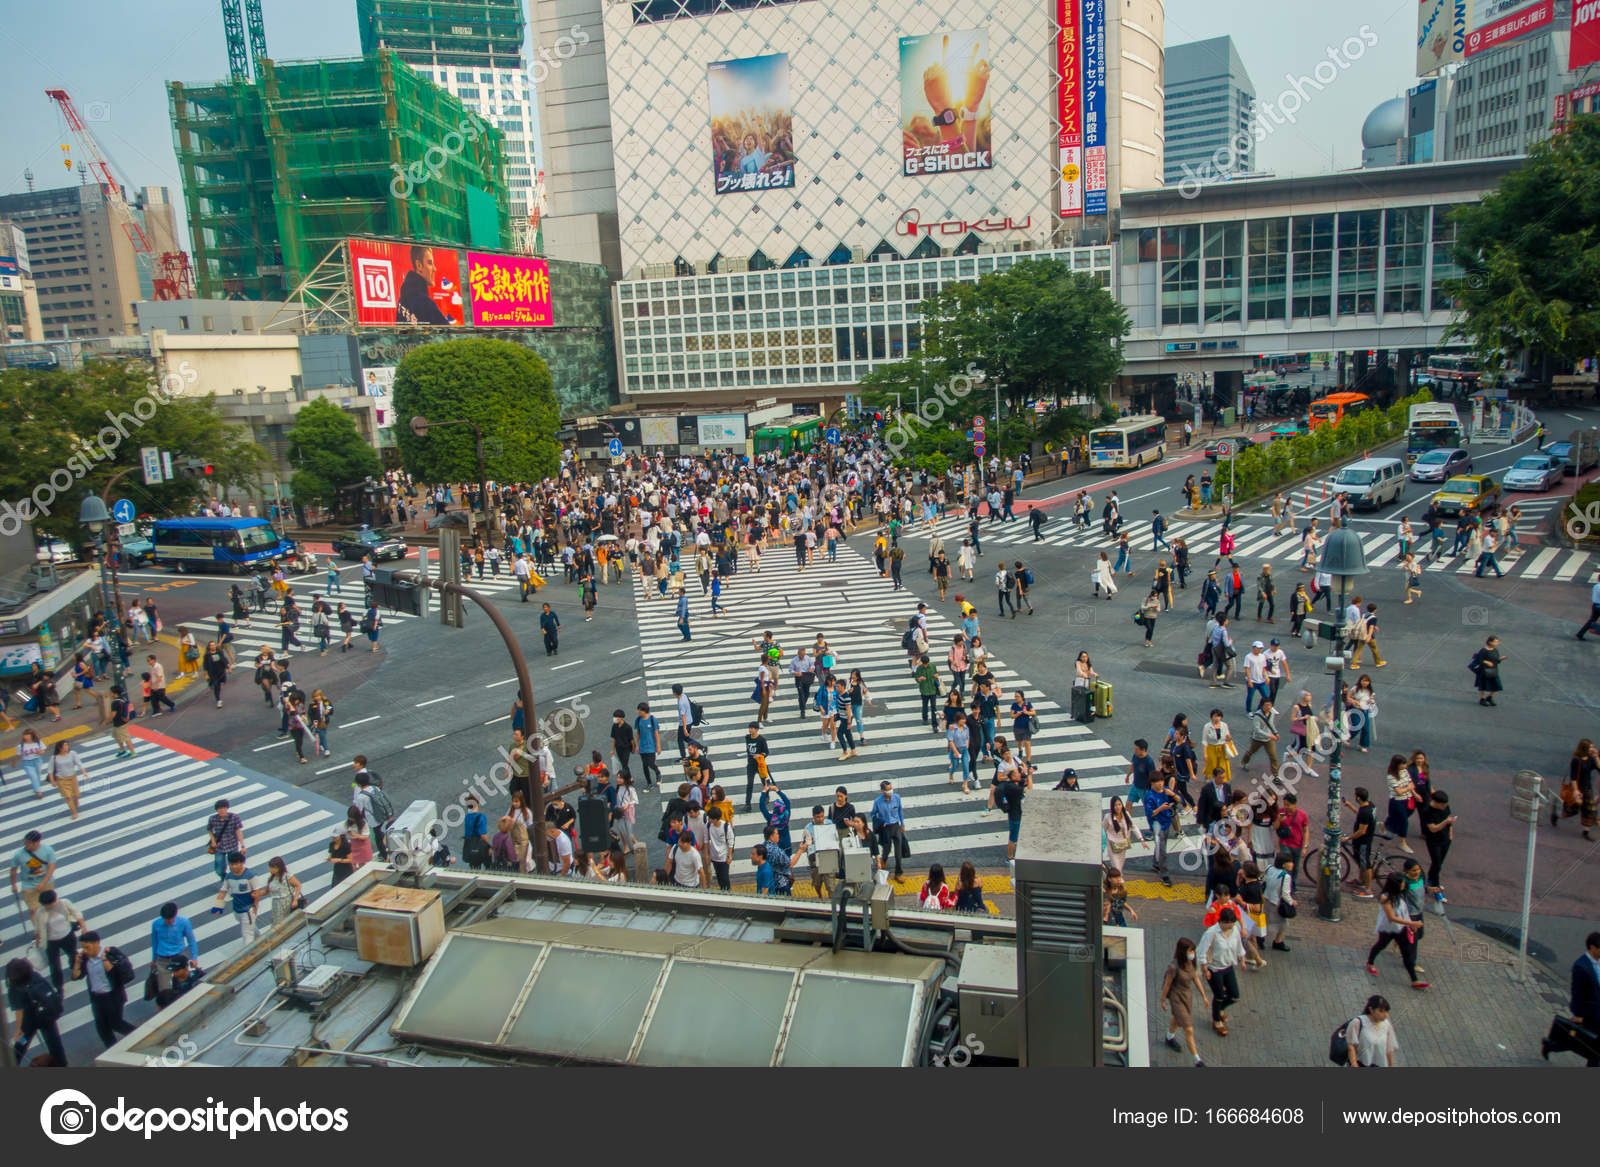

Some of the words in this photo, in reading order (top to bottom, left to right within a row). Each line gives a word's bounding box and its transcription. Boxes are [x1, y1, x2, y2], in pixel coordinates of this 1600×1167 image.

[1062, 27, 1077, 134] 夏のクリアランス
[1085, 1, 1097, 145] サマーギフトセンター開設中
[906, 144, 951, 157] フェスには
[1060, 135, 1080, 145] SALE
[905, 150, 990, 175] G-SHOCK
[717, 169, 791, 192] ブッ壊れろ!
[918, 215, 1030, 236] TOKYU
[470, 262, 549, 304] 完熟新作
